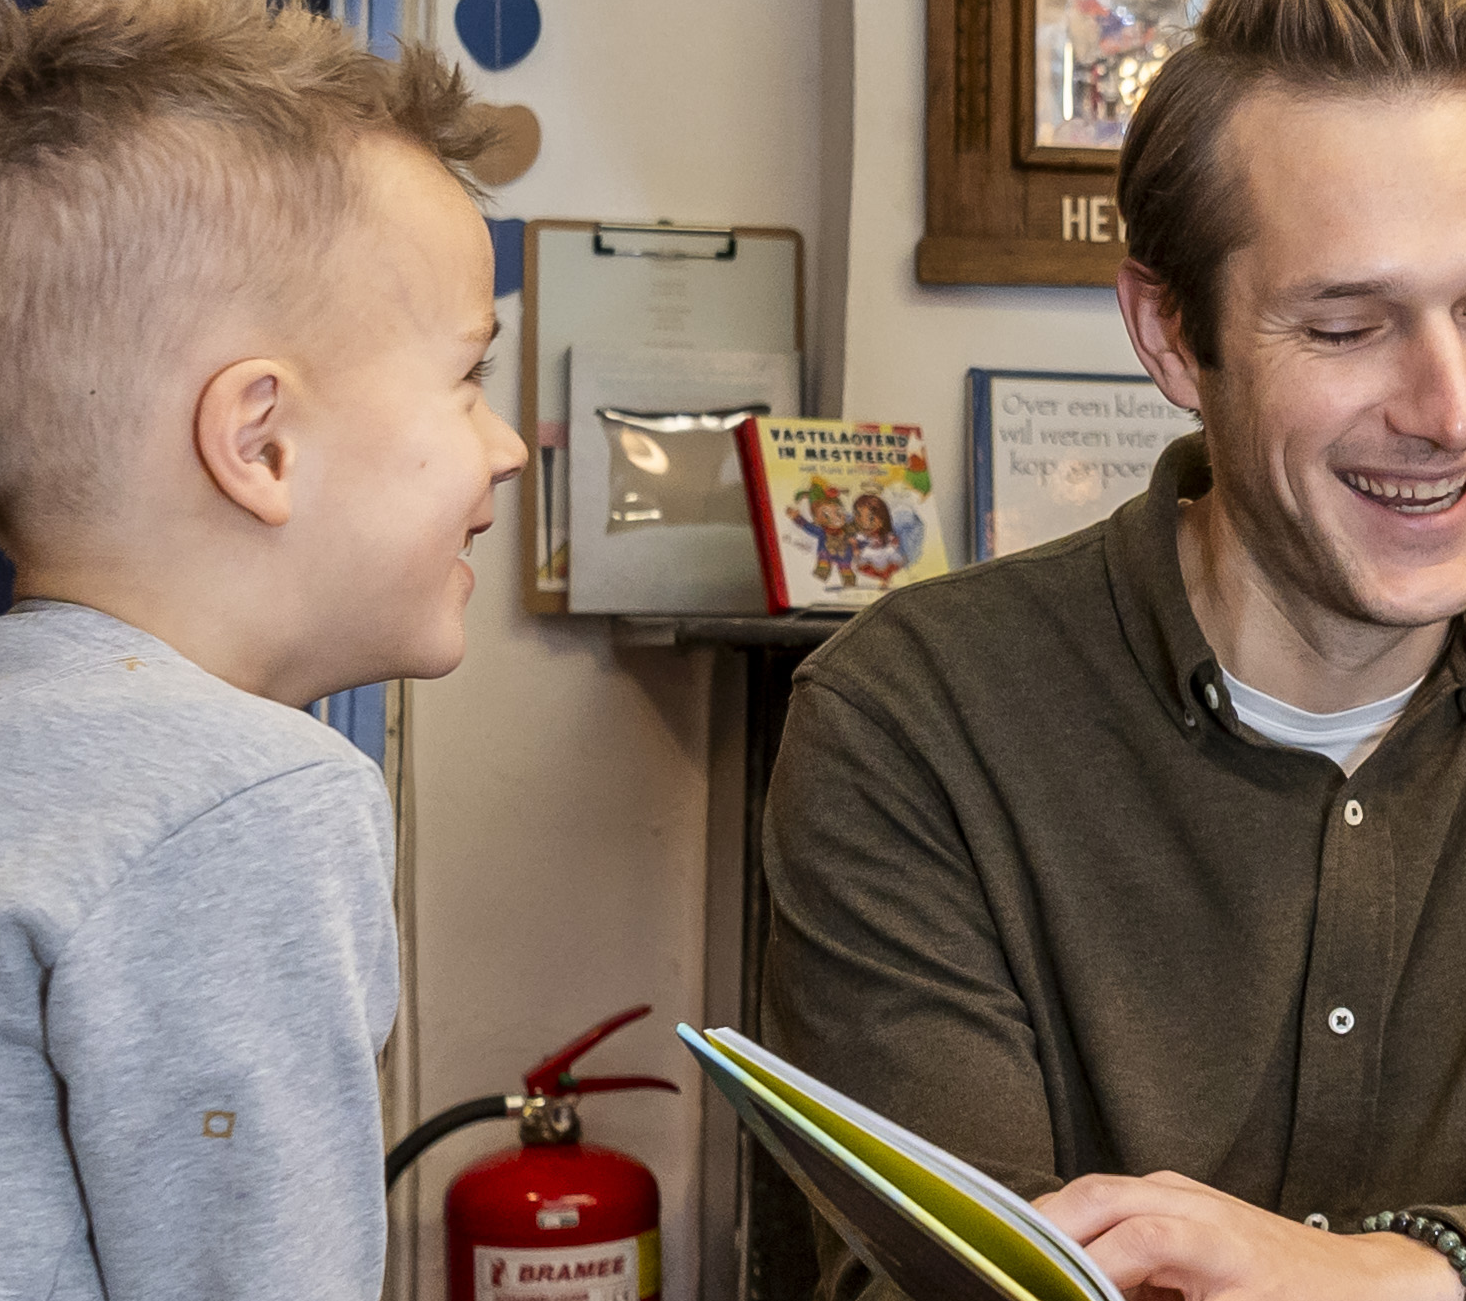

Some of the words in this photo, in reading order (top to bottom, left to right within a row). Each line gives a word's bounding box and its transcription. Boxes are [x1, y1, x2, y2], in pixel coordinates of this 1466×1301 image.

[1060, 194, 1127, 243] HE
[1002, 394, 1059, 418] Over
[1069, 399, 1111, 417] een
[770, 428, 909, 448] VASTELAOVEND
[999, 424, 1034, 446] wil
[1038, 430, 1112, 448] weten
[1117, 429, 1157, 448] wie
[778, 447, 797, 461] IN
[804, 447, 908, 465] MESTREECH
[1009, 451, 1058, 486] kop
[517, 1254, 628, 1285] BRAMEE
